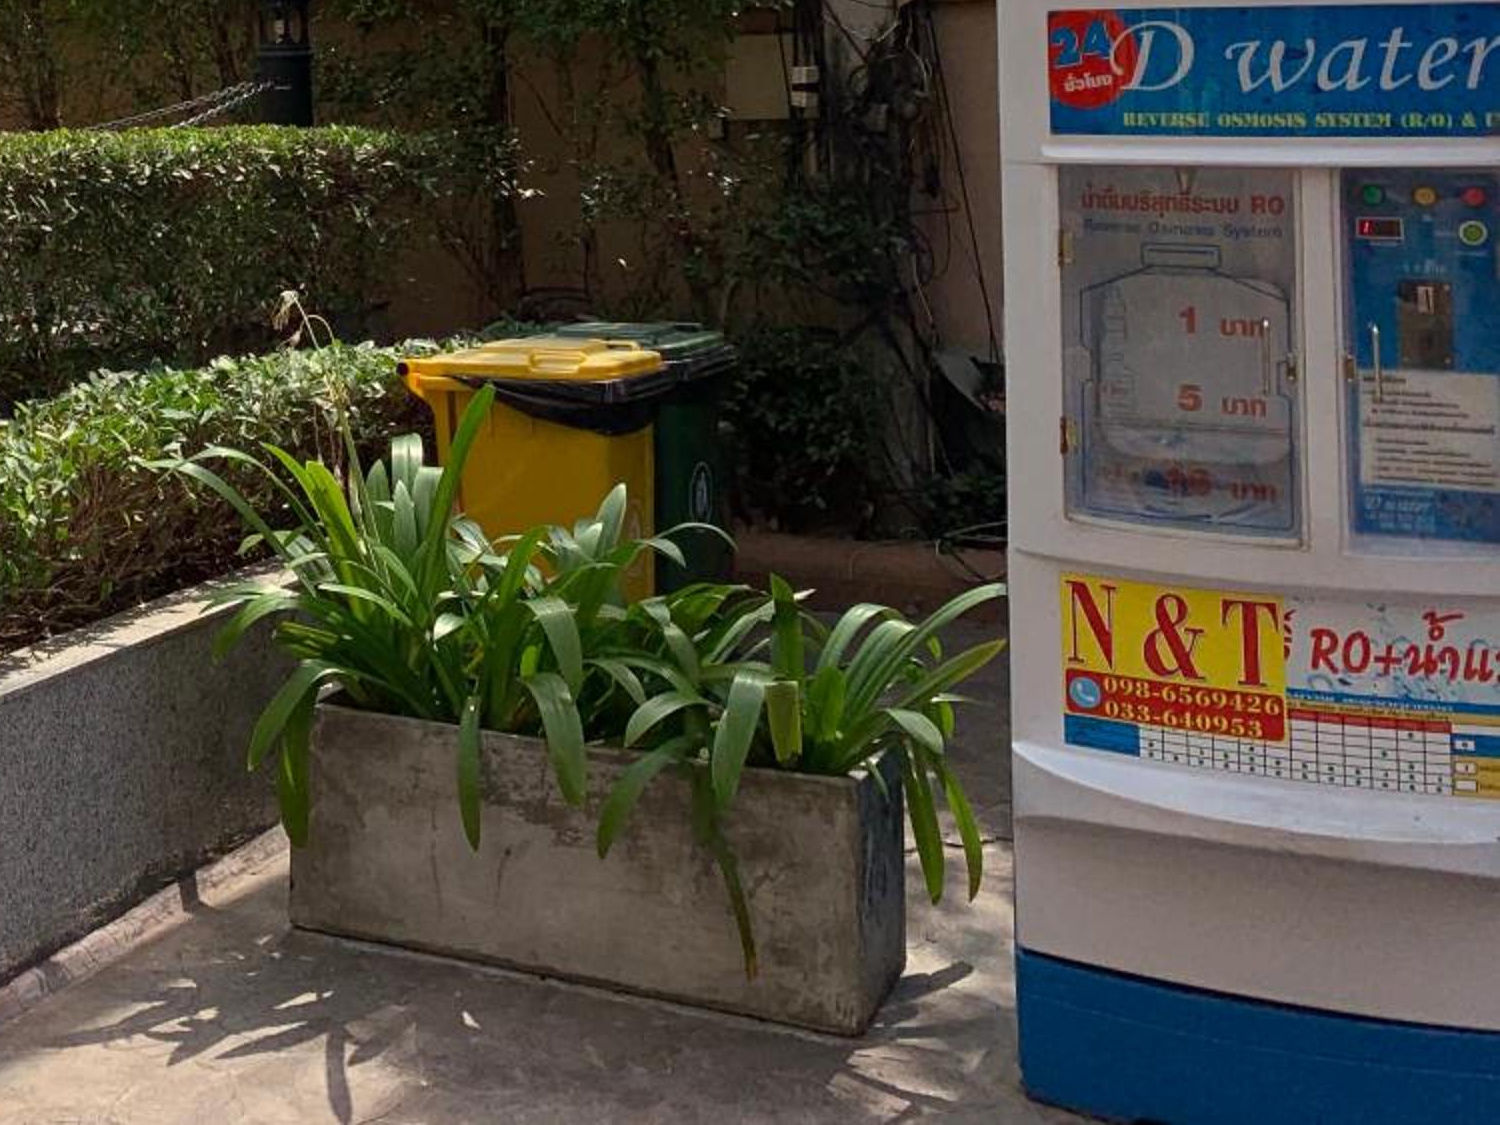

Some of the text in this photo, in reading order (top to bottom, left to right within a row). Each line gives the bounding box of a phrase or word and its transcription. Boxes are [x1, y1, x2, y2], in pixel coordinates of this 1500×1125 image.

[1109, 20, 1500, 92] D water
[1123, 111, 1210, 128] REVERSE
[1218, 111, 1307, 128] OSMOSIS
[1315, 111, 1392, 128] SYSTEM
[1251, 193, 1286, 217] RO
[1179, 306, 1266, 340] 1 บาท
[1178, 383, 1267, 418] 5 บาท
[1065, 580, 1117, 670] N
[1143, 593, 1206, 680] &
[1221, 599, 1280, 687] T
[1102, 675, 1281, 717] 098-6569426
[1104, 699, 1265, 739] 033-640953
